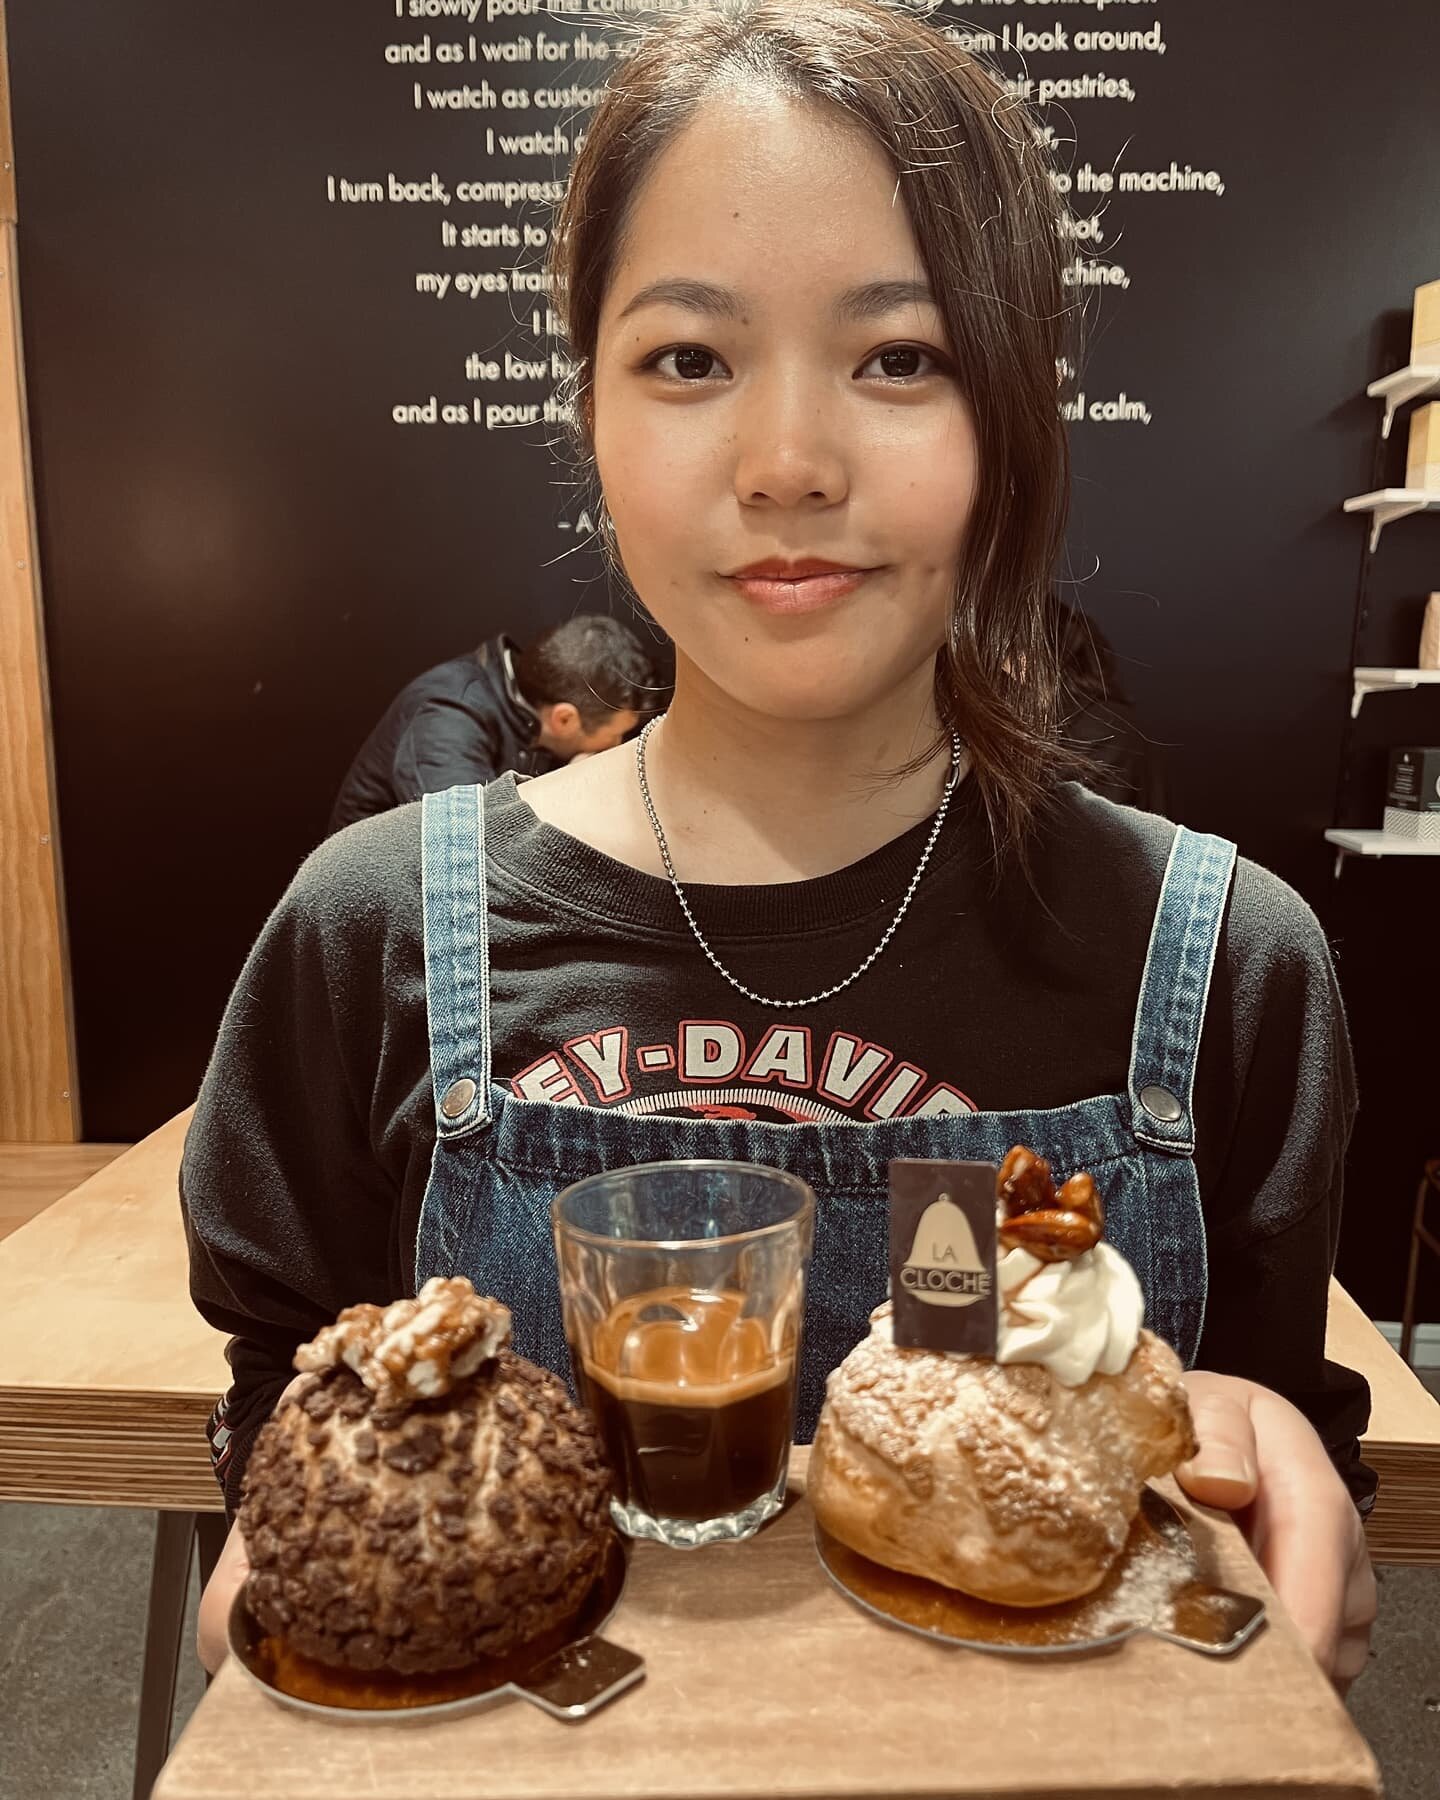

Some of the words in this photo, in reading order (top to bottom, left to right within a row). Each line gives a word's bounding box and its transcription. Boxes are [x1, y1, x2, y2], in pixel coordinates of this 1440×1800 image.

[409, 0, 480, 23] slowly
[487, 0, 539, 23] pour
[385, 35, 431, 64] and
[436, 43, 464, 63] as
[469, 35, 476, 62] I
[482, 36, 532, 63] wait
[536, 32, 570, 62] for
[574, 31, 609, 61] the
[1002, 24, 1010, 52] I
[1016, 21, 1069, 52] look
[1074, 21, 1166, 54] around,
[414, 82, 421, 110] I
[426, 79, 497, 110] watch
[501, 88, 530, 110] as
[1039, 72, 1135, 106] pastries,
[486, 127, 494, 156] I
[499, 125, 569, 155] watch
[327, 175, 335, 203] I
[340, 179, 384, 203] turn
[388, 172, 450, 206] back,
[1077, 162, 1114, 193] the
[1119, 161, 1225, 196] machine,
[442, 220, 456, 247] It
[461, 223, 520, 247] starts
[523, 222, 548, 247] to
[415, 272, 450, 299] my
[454, 273, 508, 299] eyes
[532, 309, 541, 337] I
[465, 352, 500, 381] the
[504, 351, 547, 380] low
[392, 395, 438, 425] and
[441, 403, 469, 425] as
[473, 398, 482, 424] I
[486, 403, 540, 430] pour
[1088, 392, 1152, 425] calm,
[932, 1243, 958, 1264] LA
[900, 1267, 992, 1296] CLOCHE
